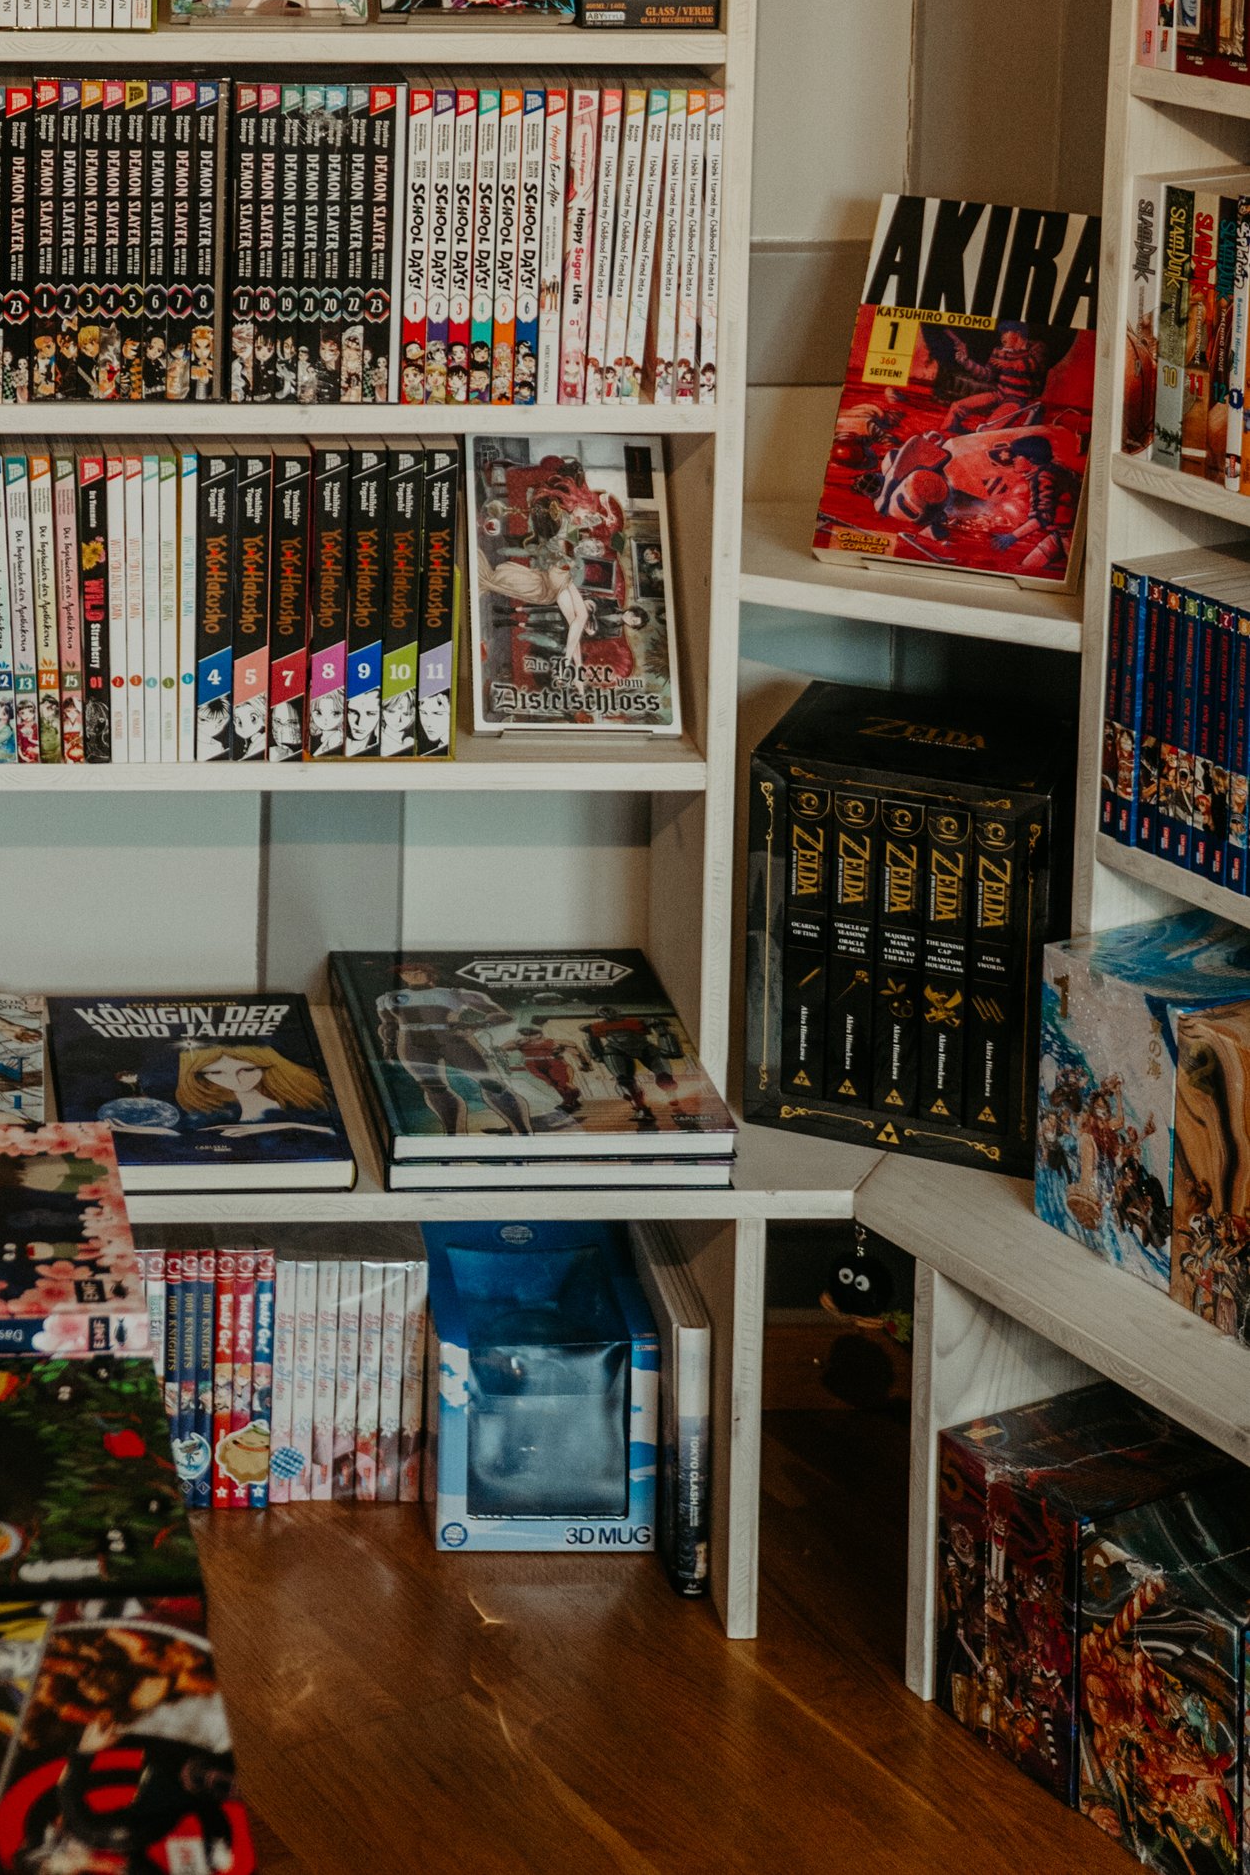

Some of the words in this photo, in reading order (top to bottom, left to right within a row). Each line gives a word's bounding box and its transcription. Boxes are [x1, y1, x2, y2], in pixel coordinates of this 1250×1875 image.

[645, 6, 676, 16] GLASS
[682, 6, 714, 15] VERRE
[410, 183, 426, 245] SCHOOL
[577, 207, 586, 245] Happy
[408, 249, 424, 291] DAYS!
[573, 248, 584, 282] Sugar
[866, 195, 1102, 330] AKIRA
[572, 284, 581, 305] Life
[876, 306, 942, 323] KATSUHIRO
[947, 314, 992, 328] OTOMO
[869, 367, 902, 378] SEITEN!
[880, 356, 897, 366] 360
[357, 663, 370, 679] 9
[426, 663, 444, 680] 11
[524, 658, 548, 671] Die
[550, 657, 613, 688] Hexe
[616, 678, 643, 688] vom
[492, 684, 660, 715] Distelschloss
[792, 825, 824, 896] ZELDA
[73, 1001, 215, 1025] KÖNIGIN
[224, 1006, 290, 1024] DER
[90, 1022, 178, 1038] 1000
[183, 1021, 280, 1039] JAHRE
[565, 1526, 594, 1545] 3D
[597, 1526, 651, 1545] MUG
